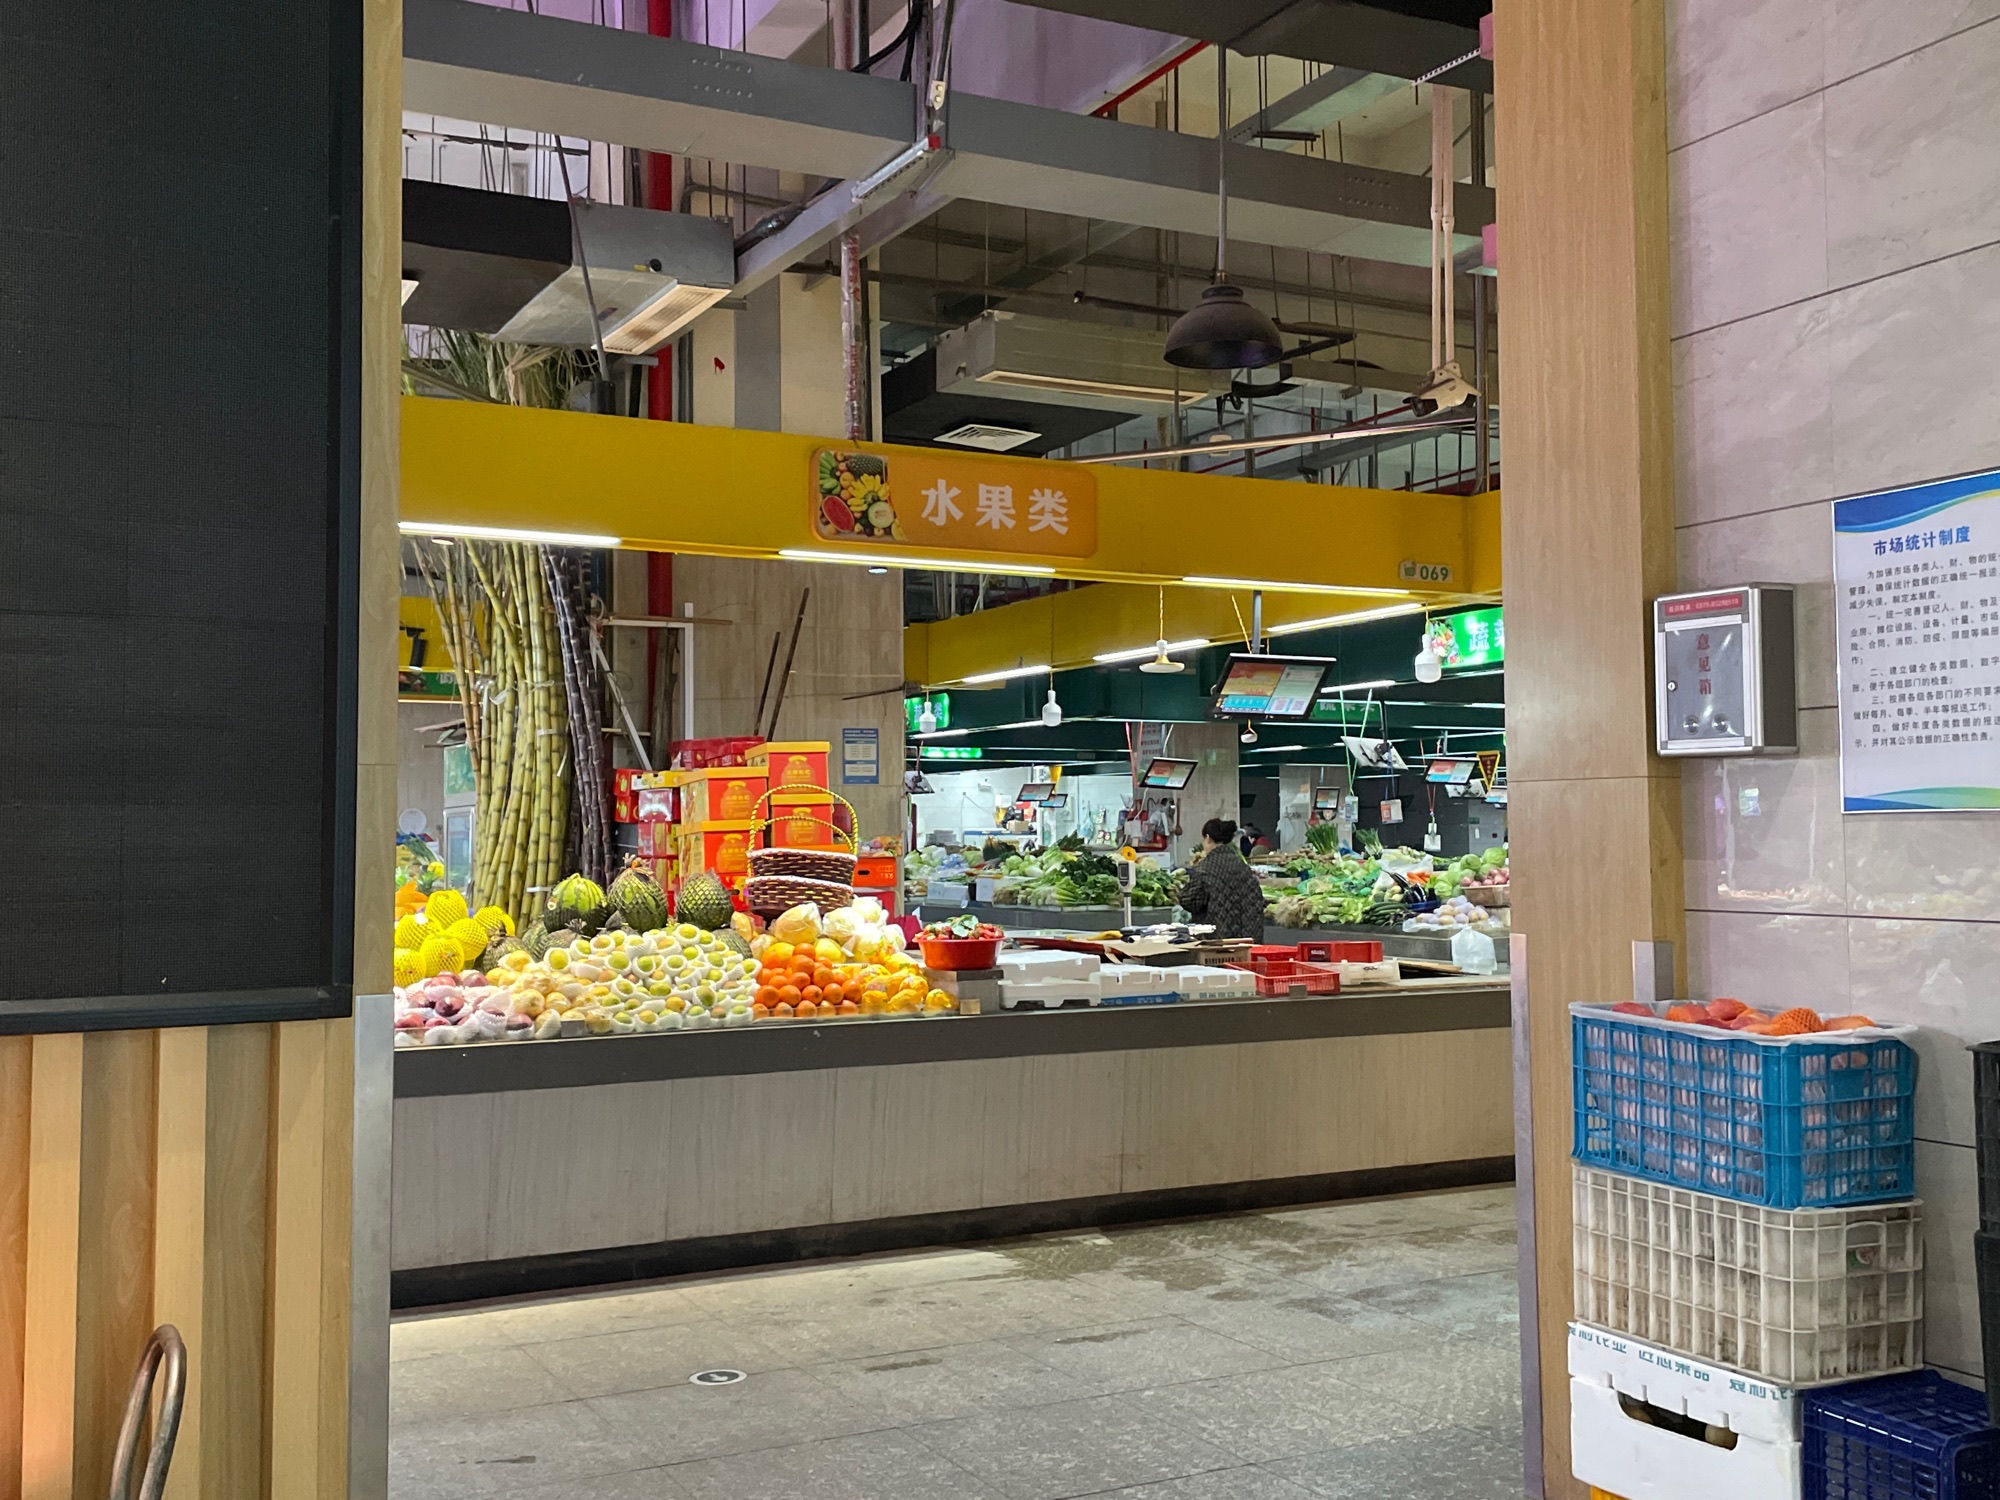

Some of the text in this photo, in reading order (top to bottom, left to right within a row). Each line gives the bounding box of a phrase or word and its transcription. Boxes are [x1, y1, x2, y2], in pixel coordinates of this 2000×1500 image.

[920, 478, 1069, 535] 水果类
[1873, 526, 1970, 556] 市场统计制度
[1420, 565, 1449, 582] 069
[1867, 552, 2000, 580] 为加强市场各类人、财、物的统
[1696, 633, 1712, 695] 意见箱
